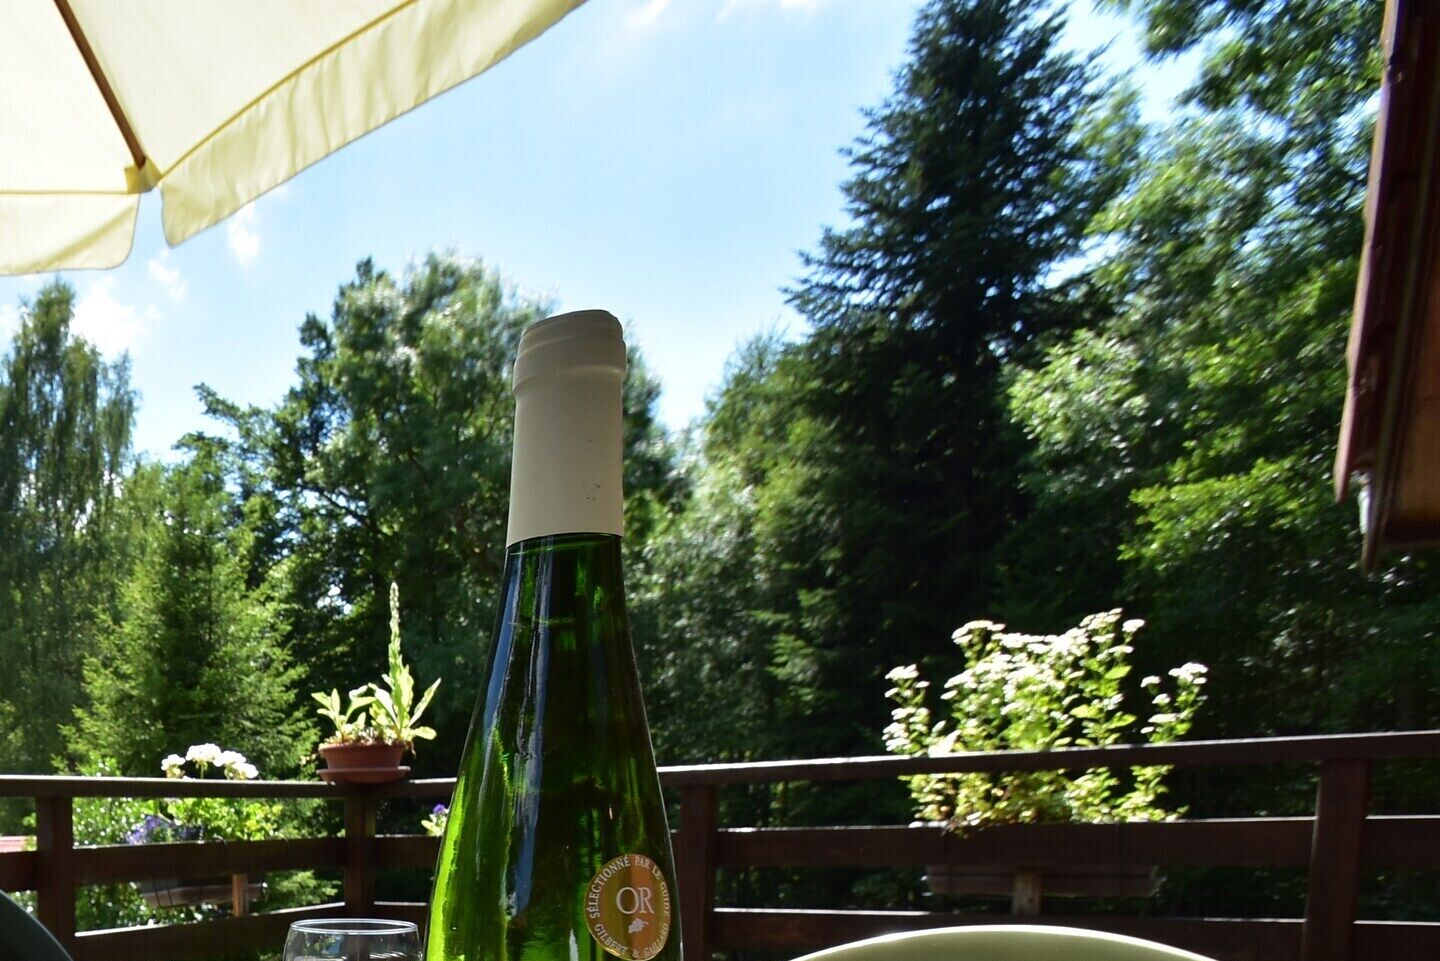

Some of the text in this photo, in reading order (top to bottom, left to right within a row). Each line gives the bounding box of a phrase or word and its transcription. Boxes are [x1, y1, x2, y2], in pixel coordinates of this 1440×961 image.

[586, 854, 631, 919] SÉLECTIONNÉ
[634, 856, 650, 868] PAR
[616, 886, 655, 915] OR
[594, 923, 629, 955] GILBERT
